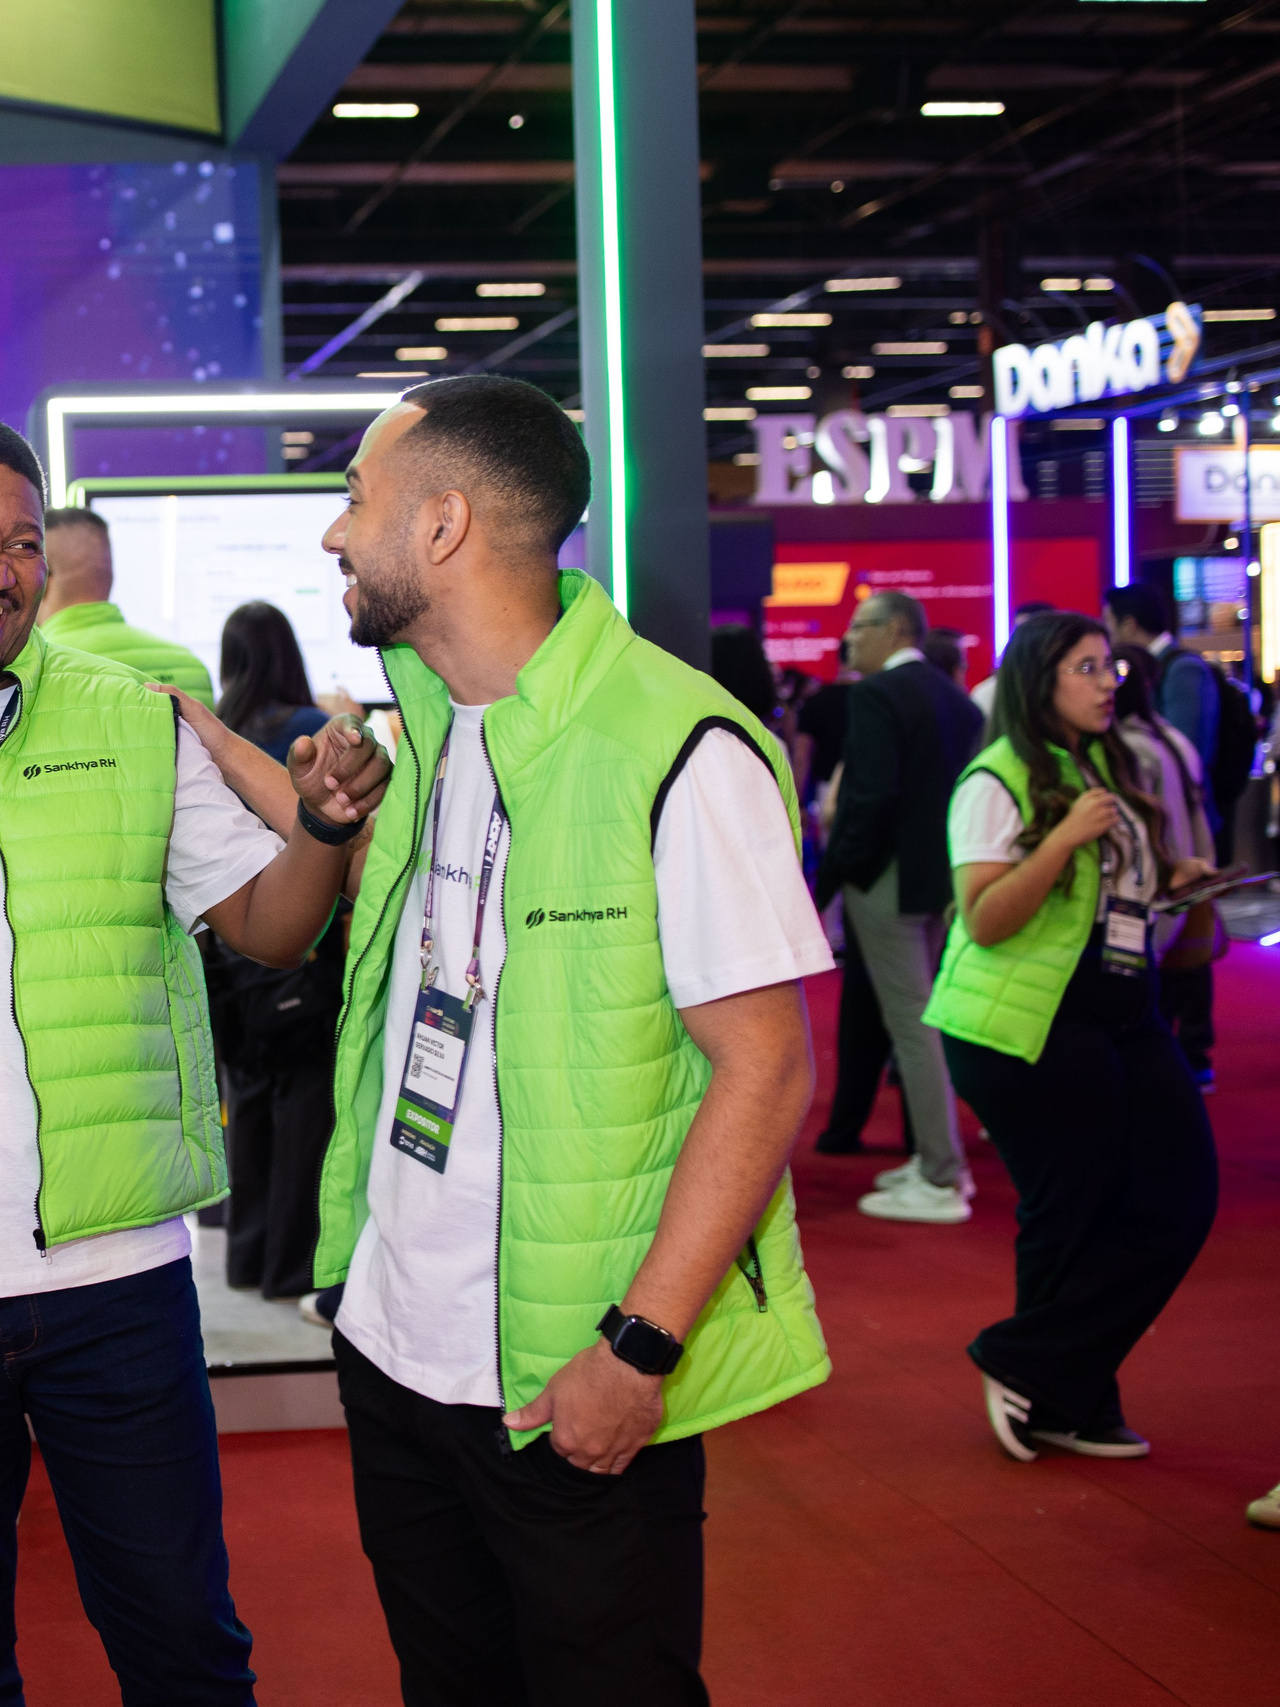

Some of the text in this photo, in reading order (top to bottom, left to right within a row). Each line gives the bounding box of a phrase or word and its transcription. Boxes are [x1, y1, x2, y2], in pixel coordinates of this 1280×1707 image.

[752, 410, 1029, 505] ESPM
[44, 759, 117, 774] Sankhya RH
[548, 907, 628, 924] Sankhya RH
[406, 1108, 440, 1134] EXPOSITOR
